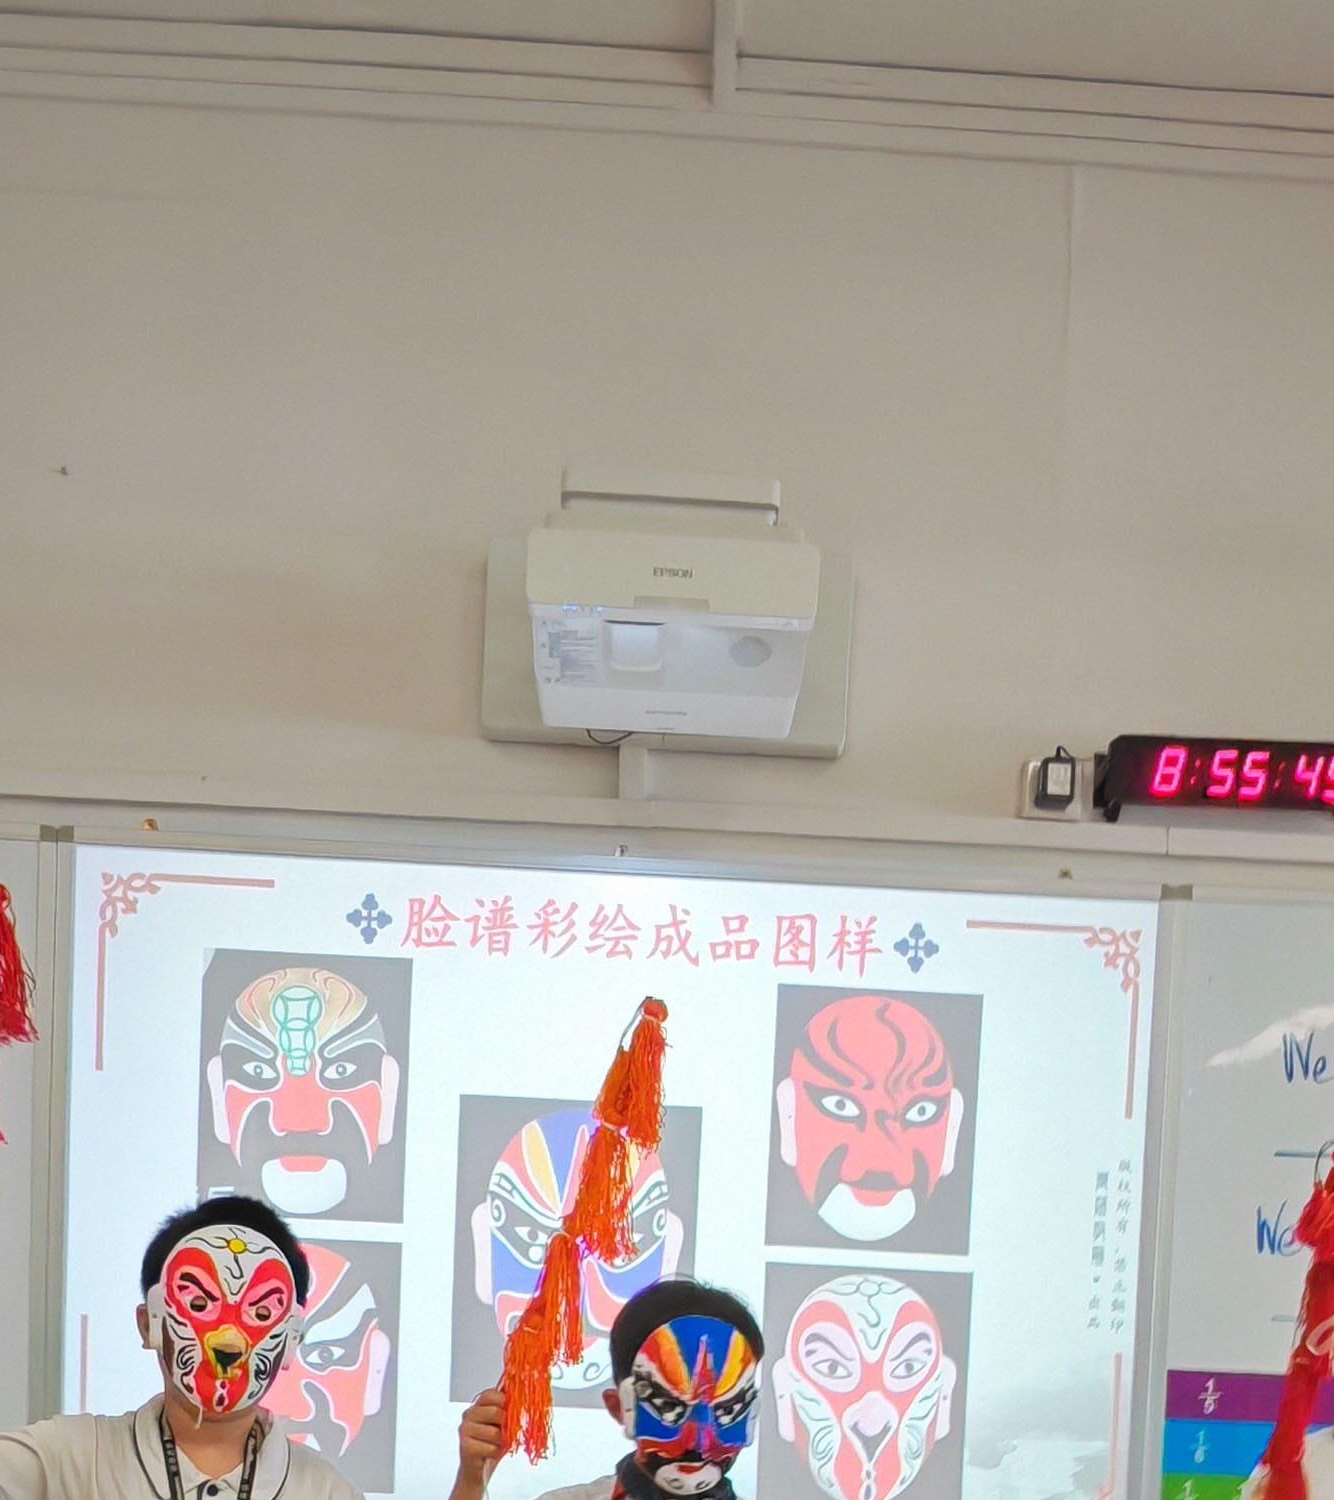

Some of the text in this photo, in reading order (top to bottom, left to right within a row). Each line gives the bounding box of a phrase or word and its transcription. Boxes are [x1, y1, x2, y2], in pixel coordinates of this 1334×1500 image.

[652, 566, 693, 579] EPSON
[400, 893, 885, 978] 脸谱彩绘成品图样
